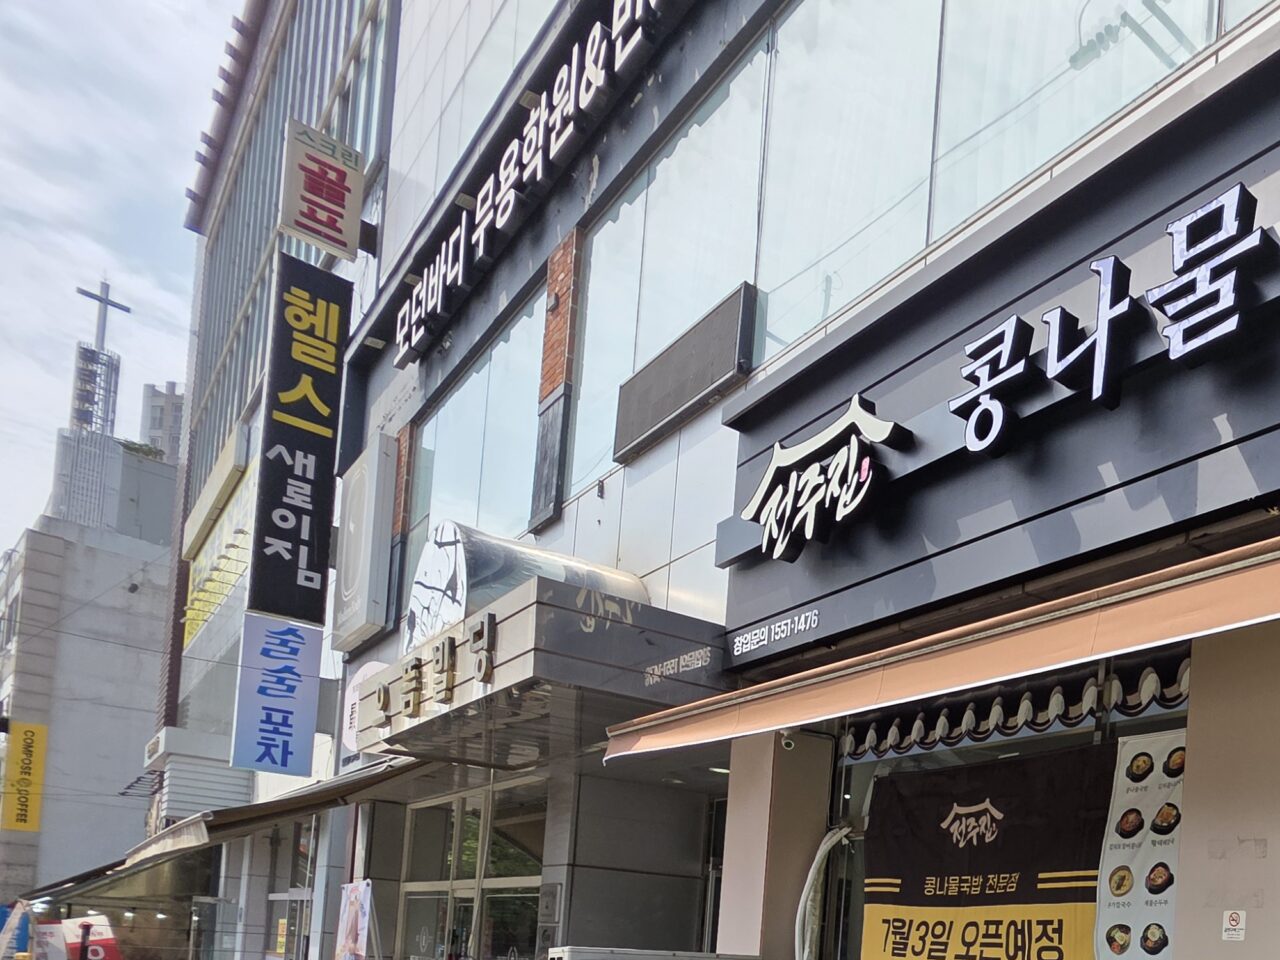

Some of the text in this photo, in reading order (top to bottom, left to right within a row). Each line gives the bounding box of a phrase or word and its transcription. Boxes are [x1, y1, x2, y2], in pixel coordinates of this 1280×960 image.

[294, 130, 360, 172] 스크린
[294, 152, 351, 248] 골프
[392, 210, 467, 361] 모던바디
[272, 285, 340, 438] 헬스
[263, 444, 322, 590] 새로이짐
[256, 626, 306, 699] 술술
[733, 629, 768, 656] 창업문의
[20, 729, 35, 776] COMPOSE
[255, 705, 294, 768] 포차
[924, 871, 1021, 896] 콩나물국밥 전문점
[881, 917, 954, 960] 7월3일
